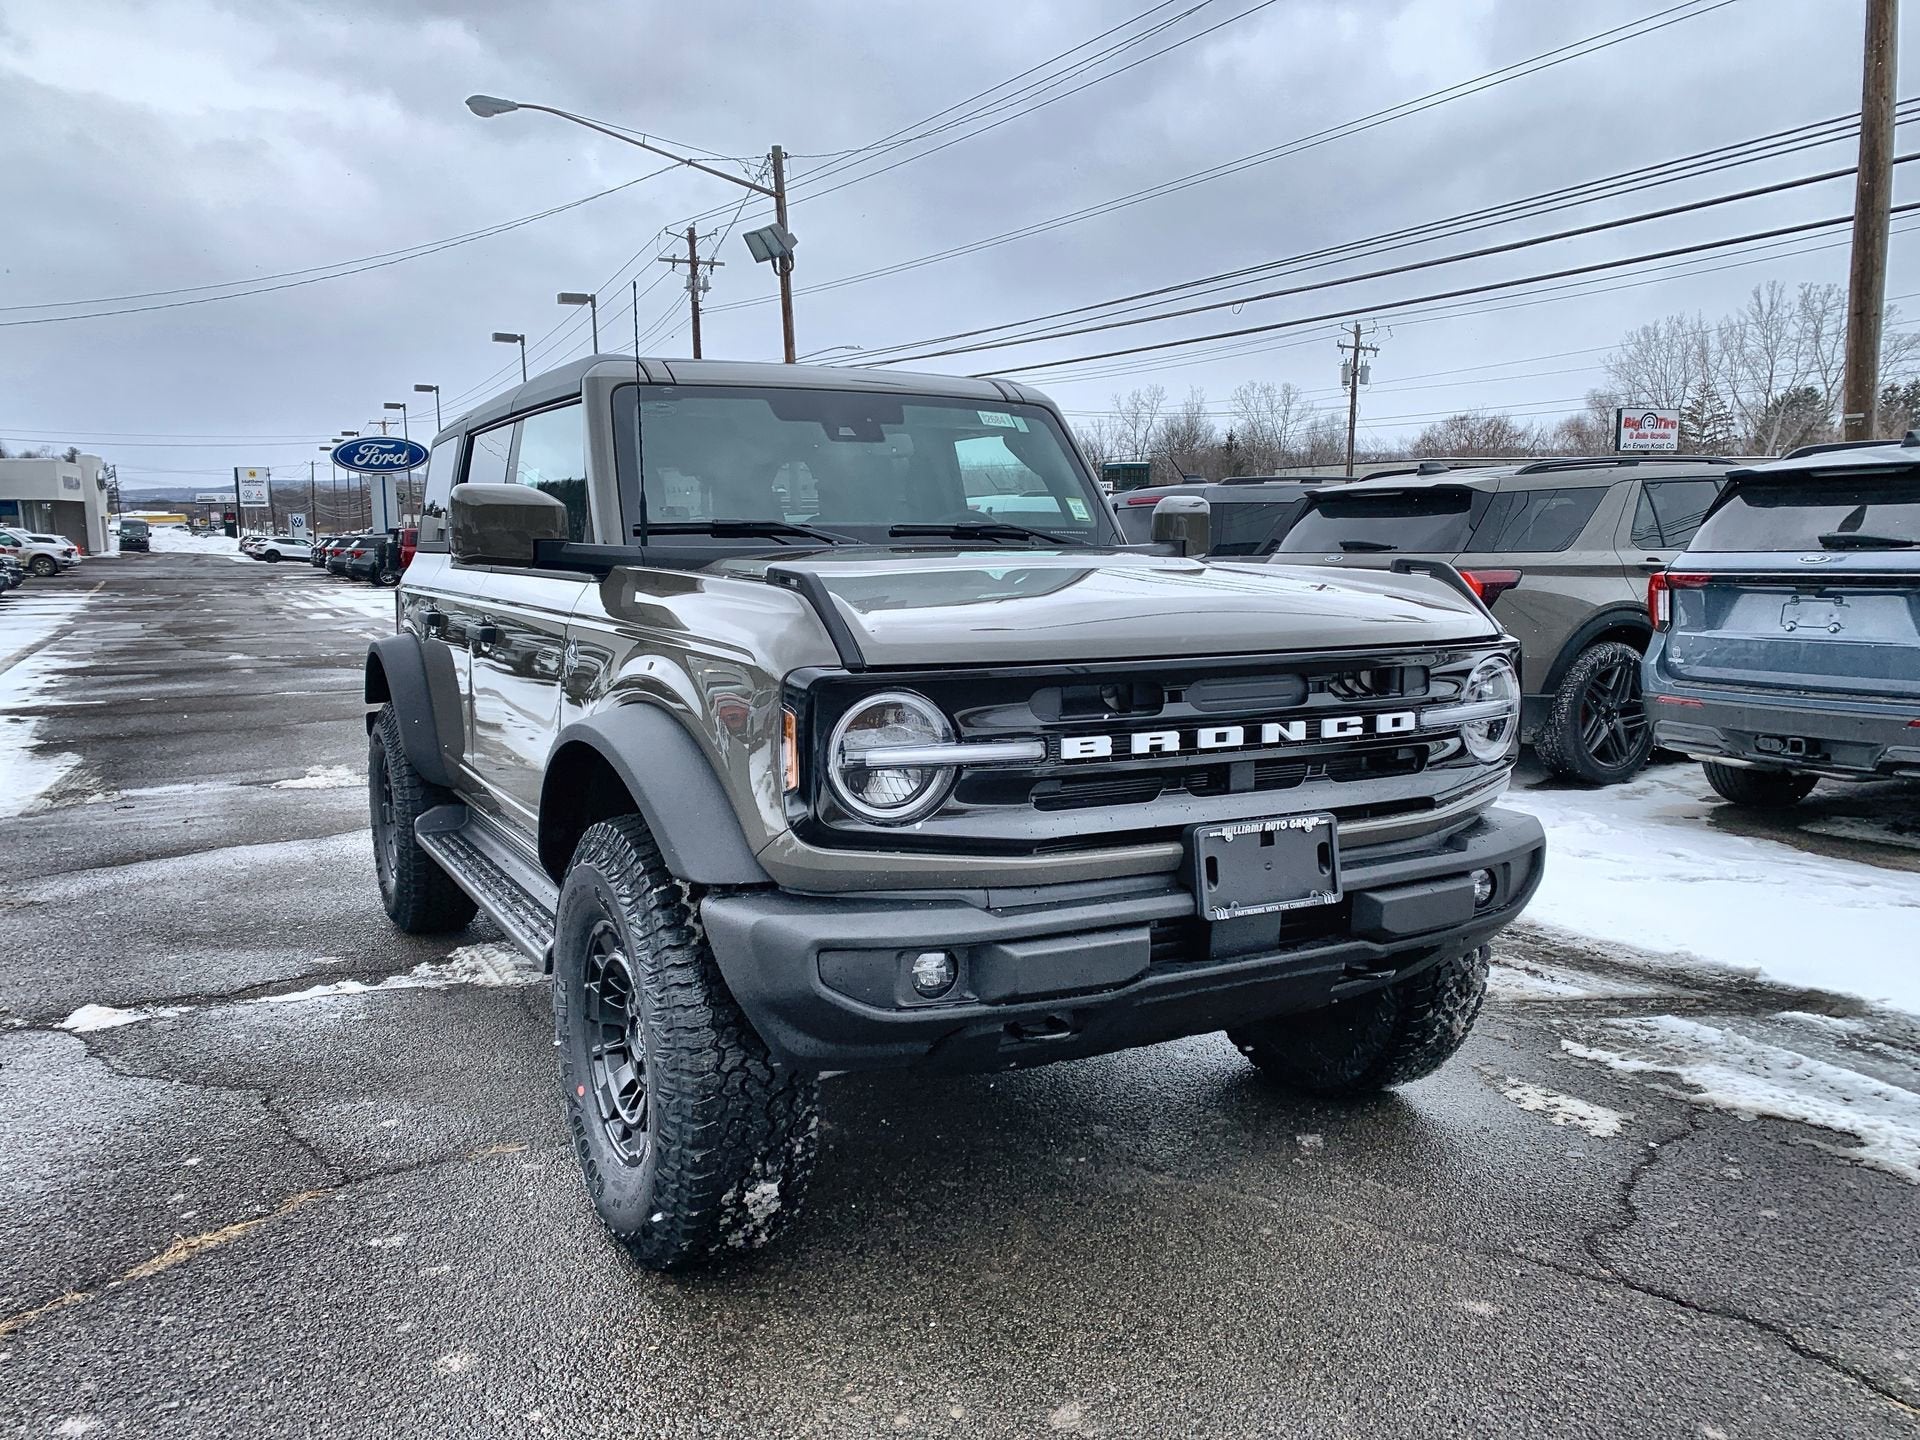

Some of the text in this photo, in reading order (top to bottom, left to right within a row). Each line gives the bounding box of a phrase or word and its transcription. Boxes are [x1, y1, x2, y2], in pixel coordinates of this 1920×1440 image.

[1623, 416, 1677, 431] Big Tire
[353, 443, 409, 466] Ford
[1060, 711, 1416, 760] BRONCO
[1264, 820, 1288, 832] AUTO
[1265, 903, 1280, 913] WITH
